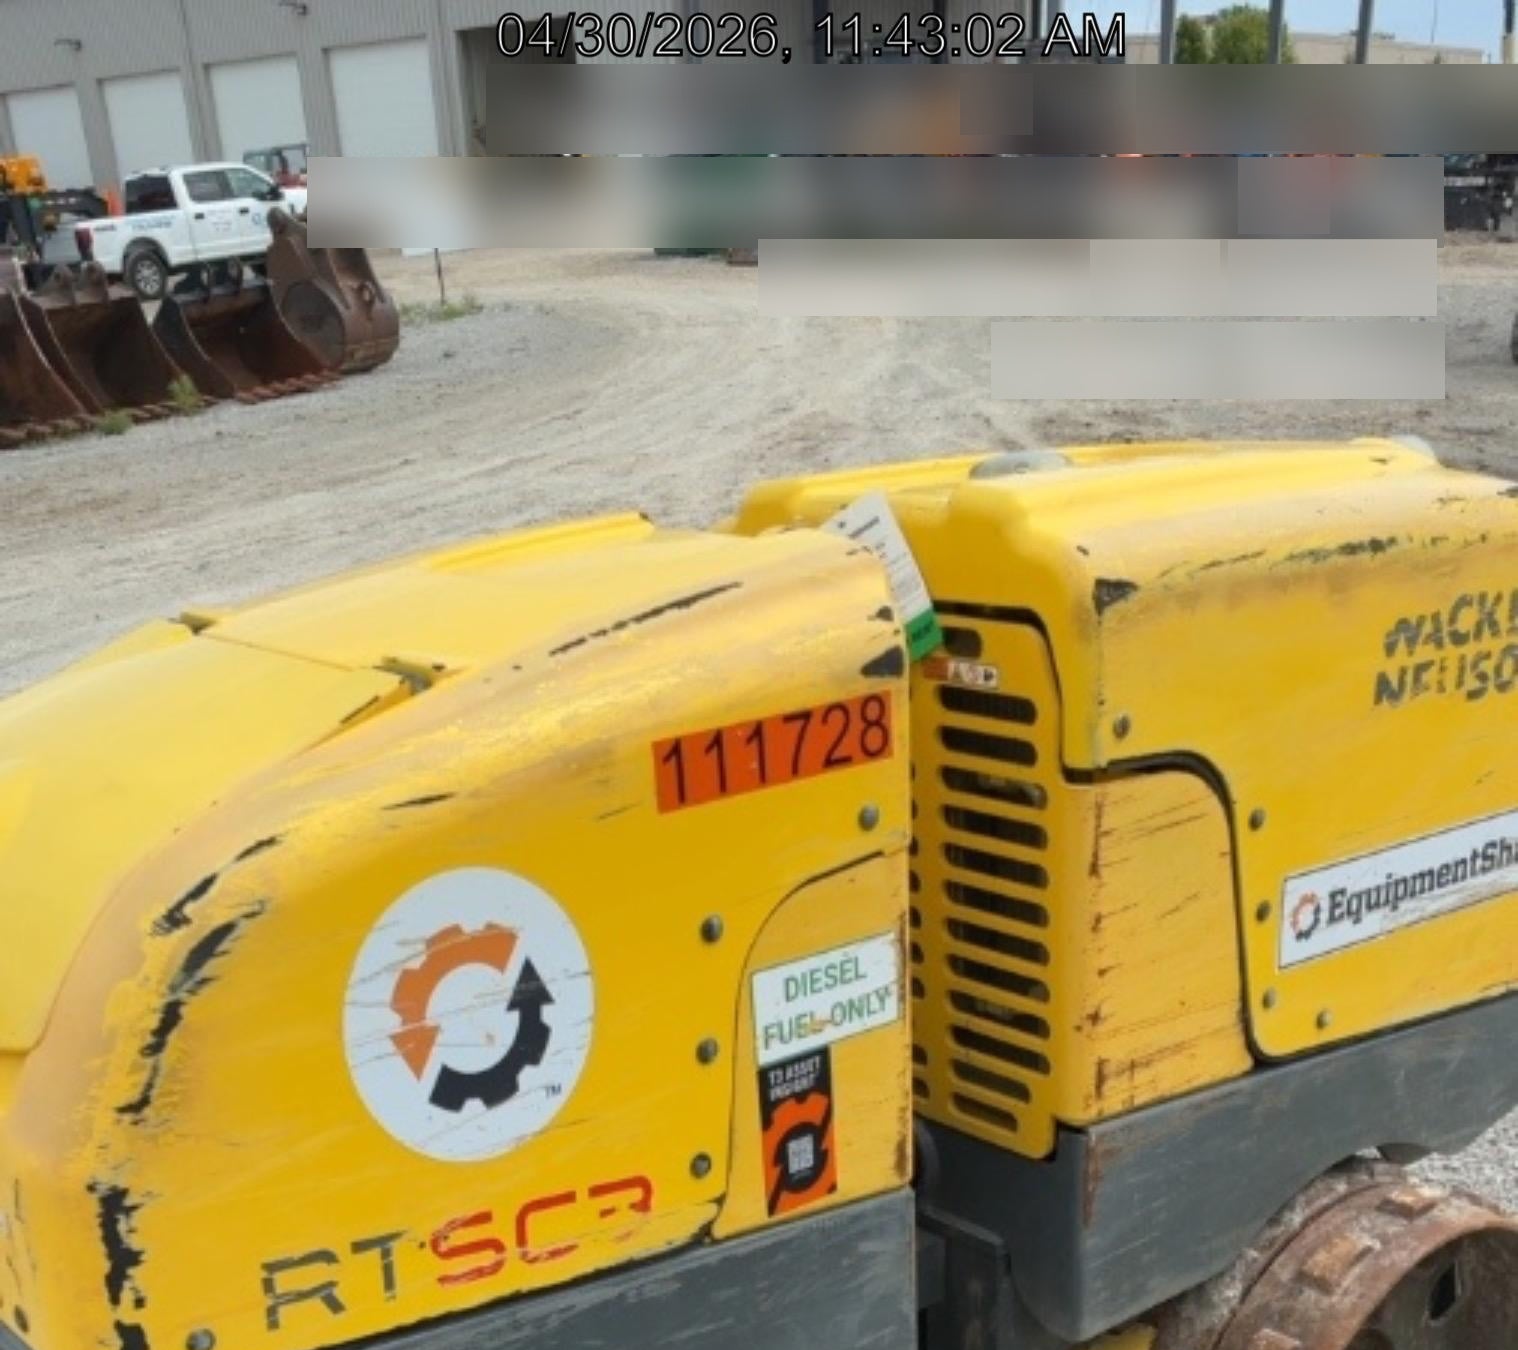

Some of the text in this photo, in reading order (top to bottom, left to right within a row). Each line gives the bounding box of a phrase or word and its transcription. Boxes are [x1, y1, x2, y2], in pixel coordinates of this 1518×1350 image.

[661, 693, 889, 806] 111728
[1327, 836, 1518, 925] EquipmentSh
[763, 984, 891, 1050] FUEL ONLY
[784, 955, 867, 1002] DIESEL
